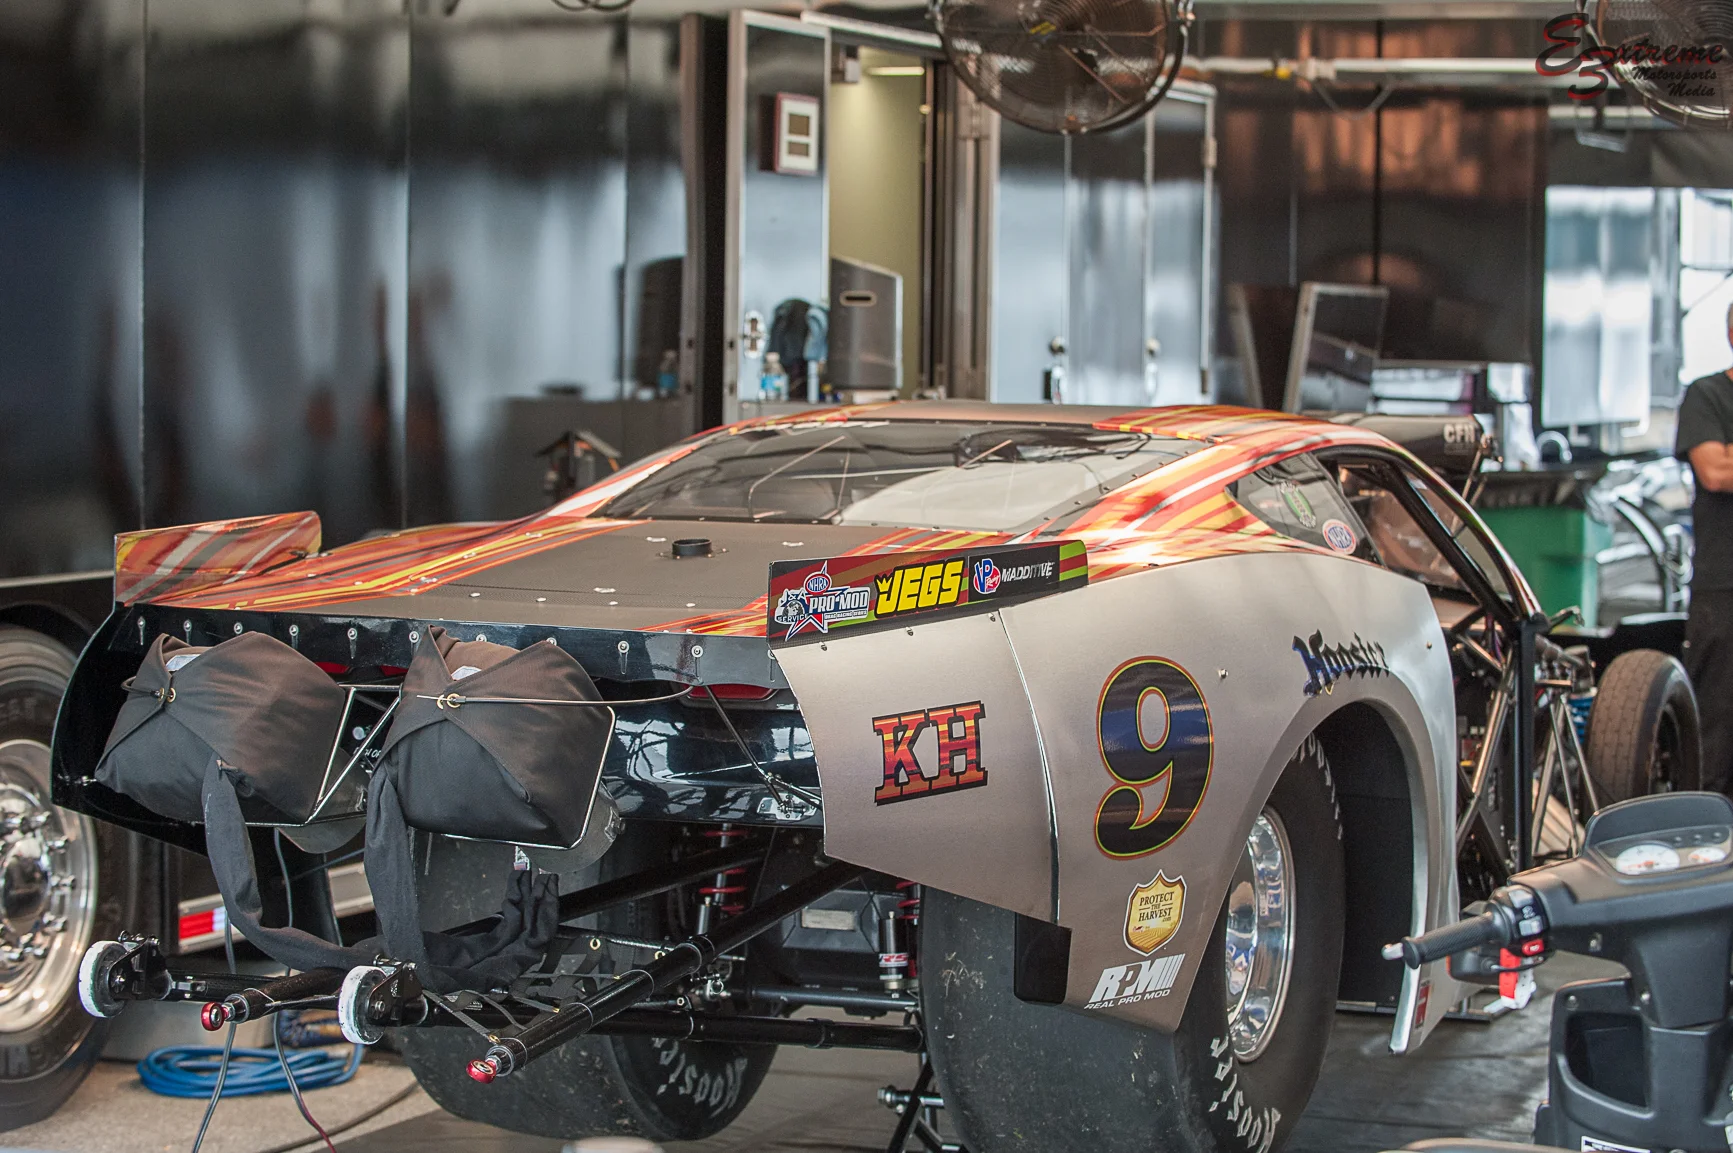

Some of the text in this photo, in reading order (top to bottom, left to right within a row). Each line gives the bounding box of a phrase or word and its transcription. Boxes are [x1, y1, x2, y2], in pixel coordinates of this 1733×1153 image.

[974, 558, 993, 593] VP
[1001, 561, 1054, 583] MADDITIVE
[808, 576, 828, 593] NHRA
[876, 560, 964, 615] JEGS
[809, 591, 869, 613] PRO MOD
[872, 700, 988, 806] KH
[1094, 655, 1214, 861] 9
[1139, 891, 1175, 906] PROTECT
[1138, 907, 1173, 922] HARVEST
[1088, 953, 1186, 1004] RPM
[1084, 989, 1171, 1010] REAL PRO MOD
